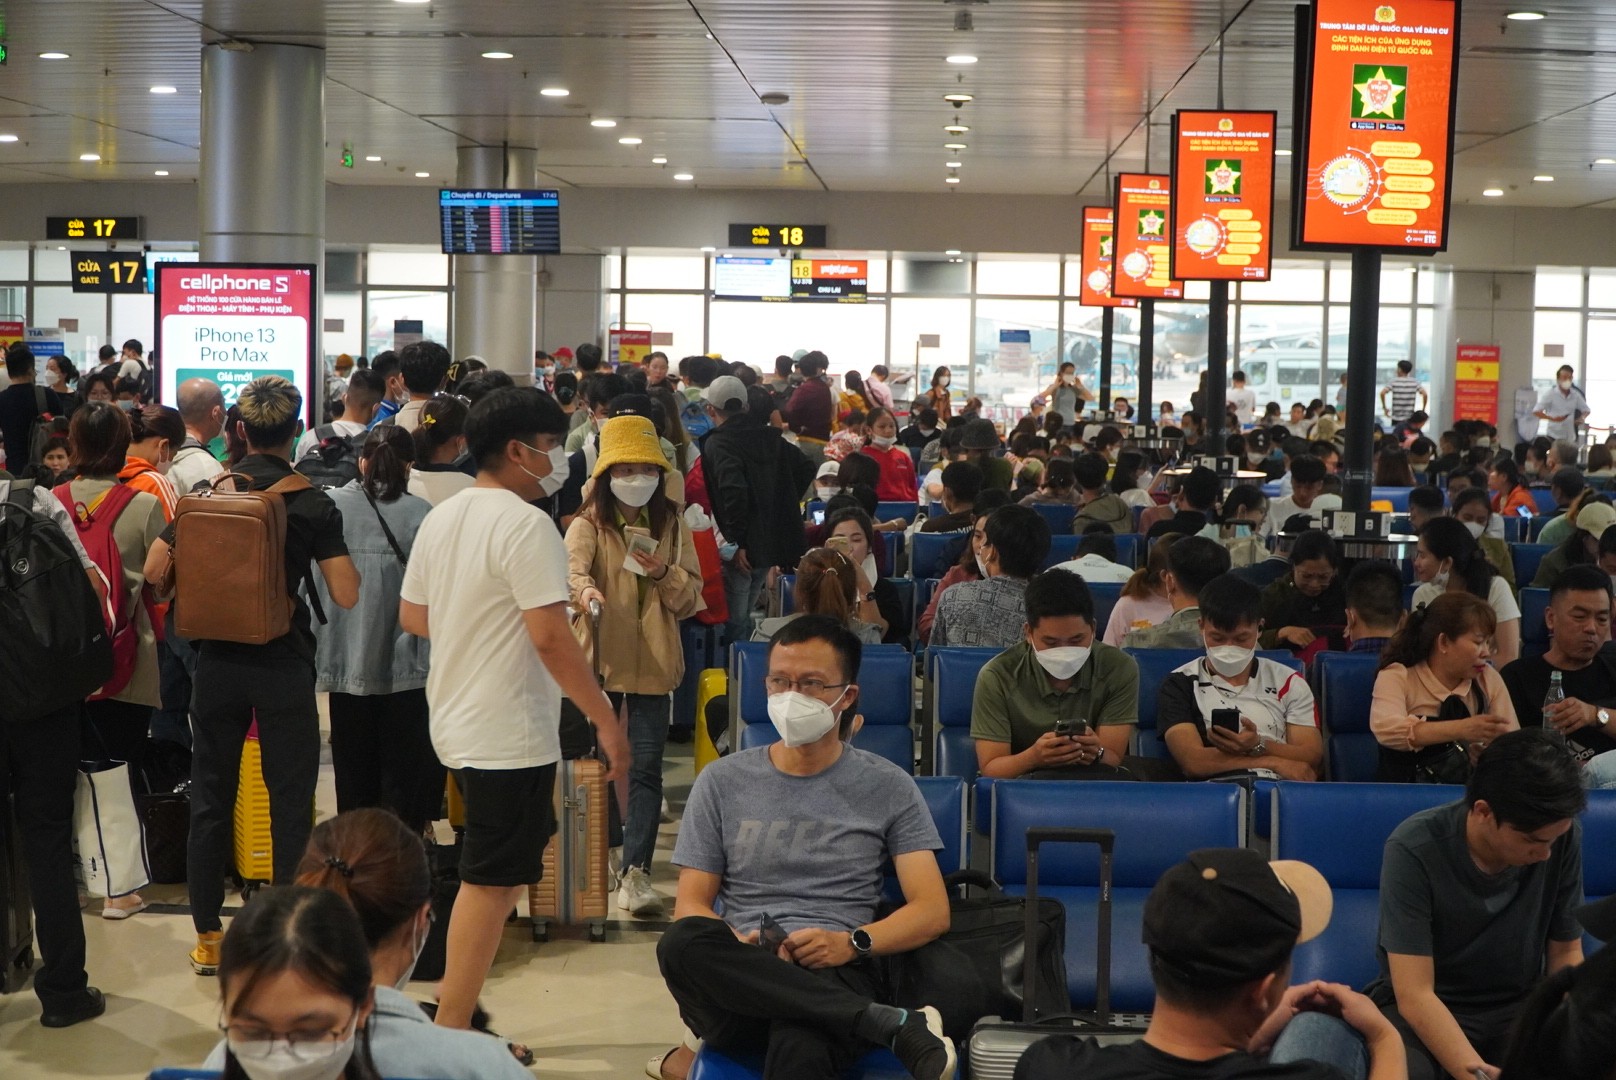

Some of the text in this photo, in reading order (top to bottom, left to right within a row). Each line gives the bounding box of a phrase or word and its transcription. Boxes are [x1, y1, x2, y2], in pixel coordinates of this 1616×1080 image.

[93, 219, 116, 237] 17
[779, 227, 804, 246] 18
[78, 259, 101, 273] CỬA
[109, 261, 139, 284] 17
[795, 266, 809, 277] 18
[80, 276, 100, 284] GATE
[180, 274, 271, 294] cellphone
[195, 327, 275, 343] iPhone 13
[201, 346, 268, 362] Pro Max
